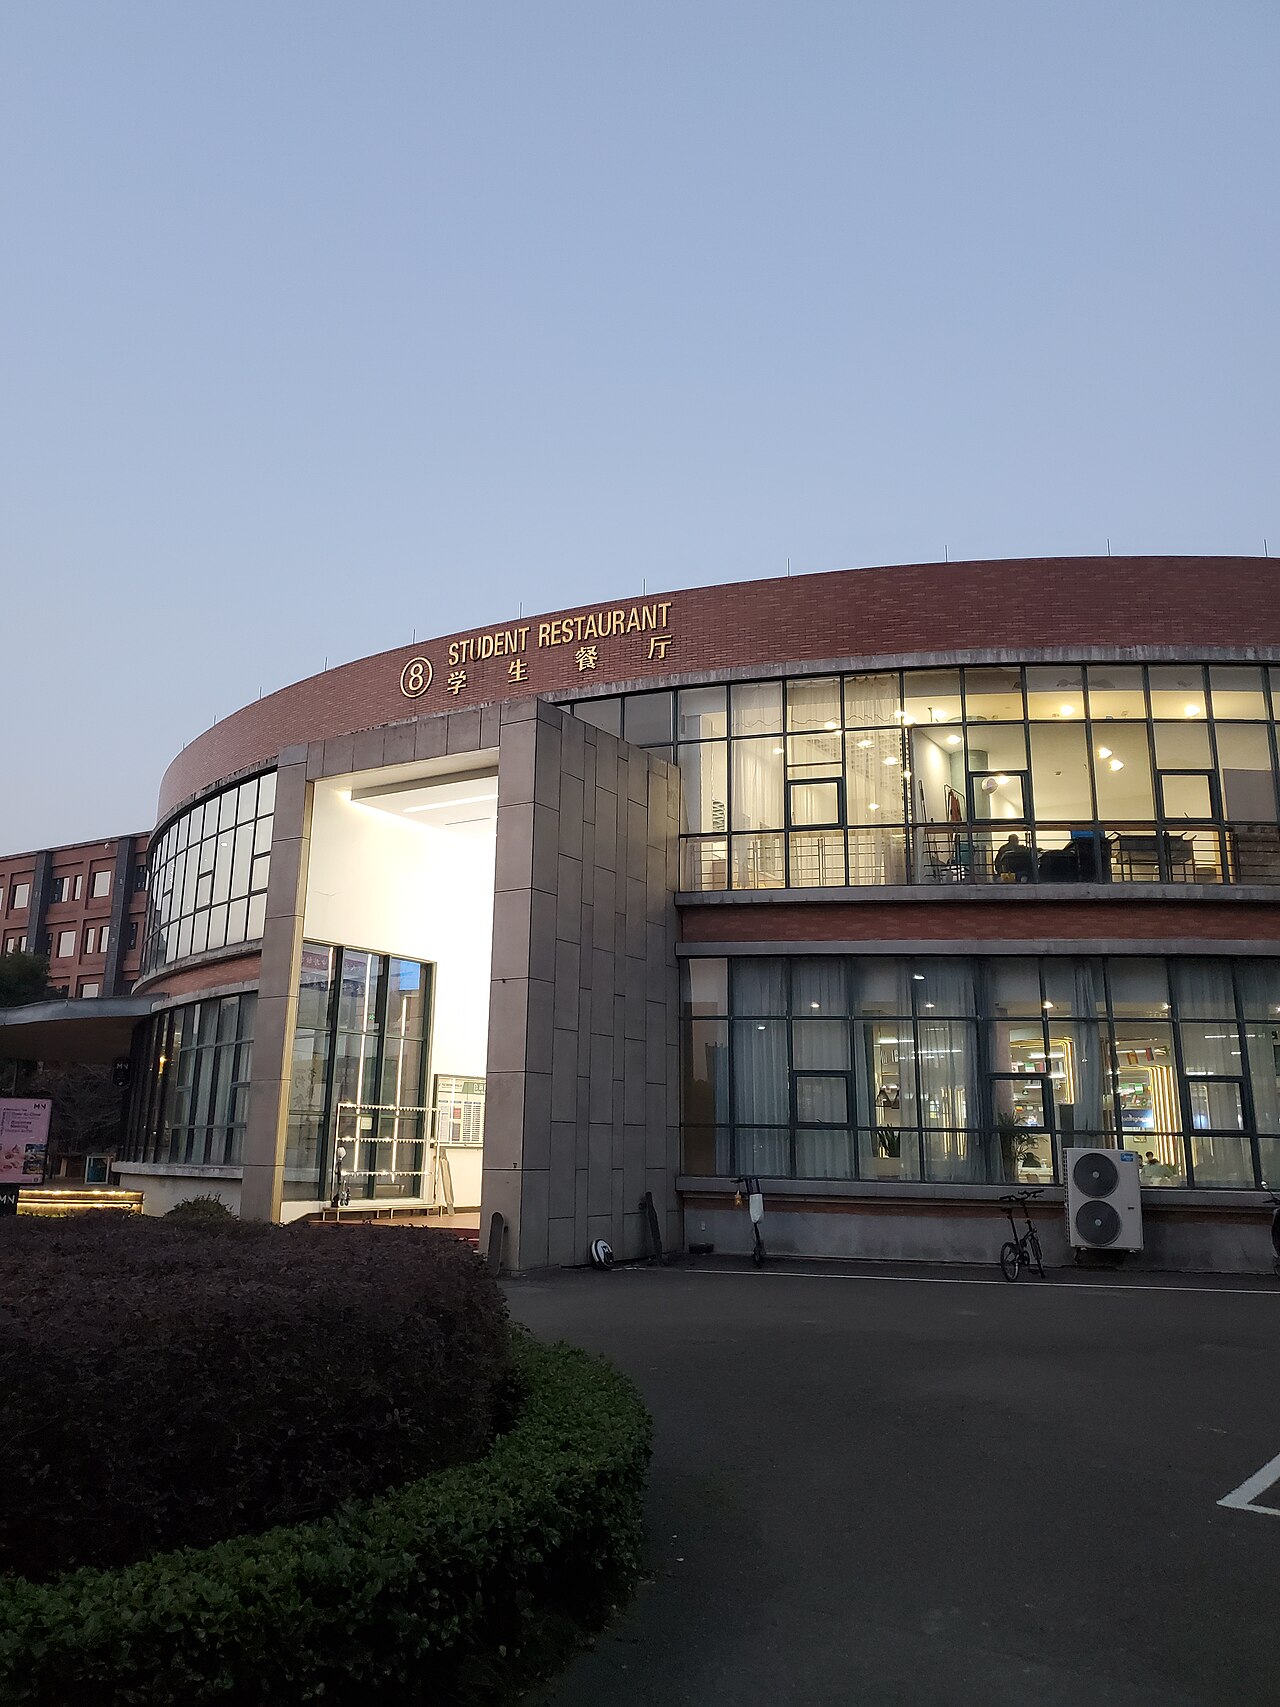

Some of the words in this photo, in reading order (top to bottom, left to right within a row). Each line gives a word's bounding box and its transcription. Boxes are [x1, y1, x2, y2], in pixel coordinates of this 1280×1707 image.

[446, 634, 673, 695] 学生餐厅
[448, 626, 530, 666] STUDENT
[538, 601, 673, 648] RESTAURANT
